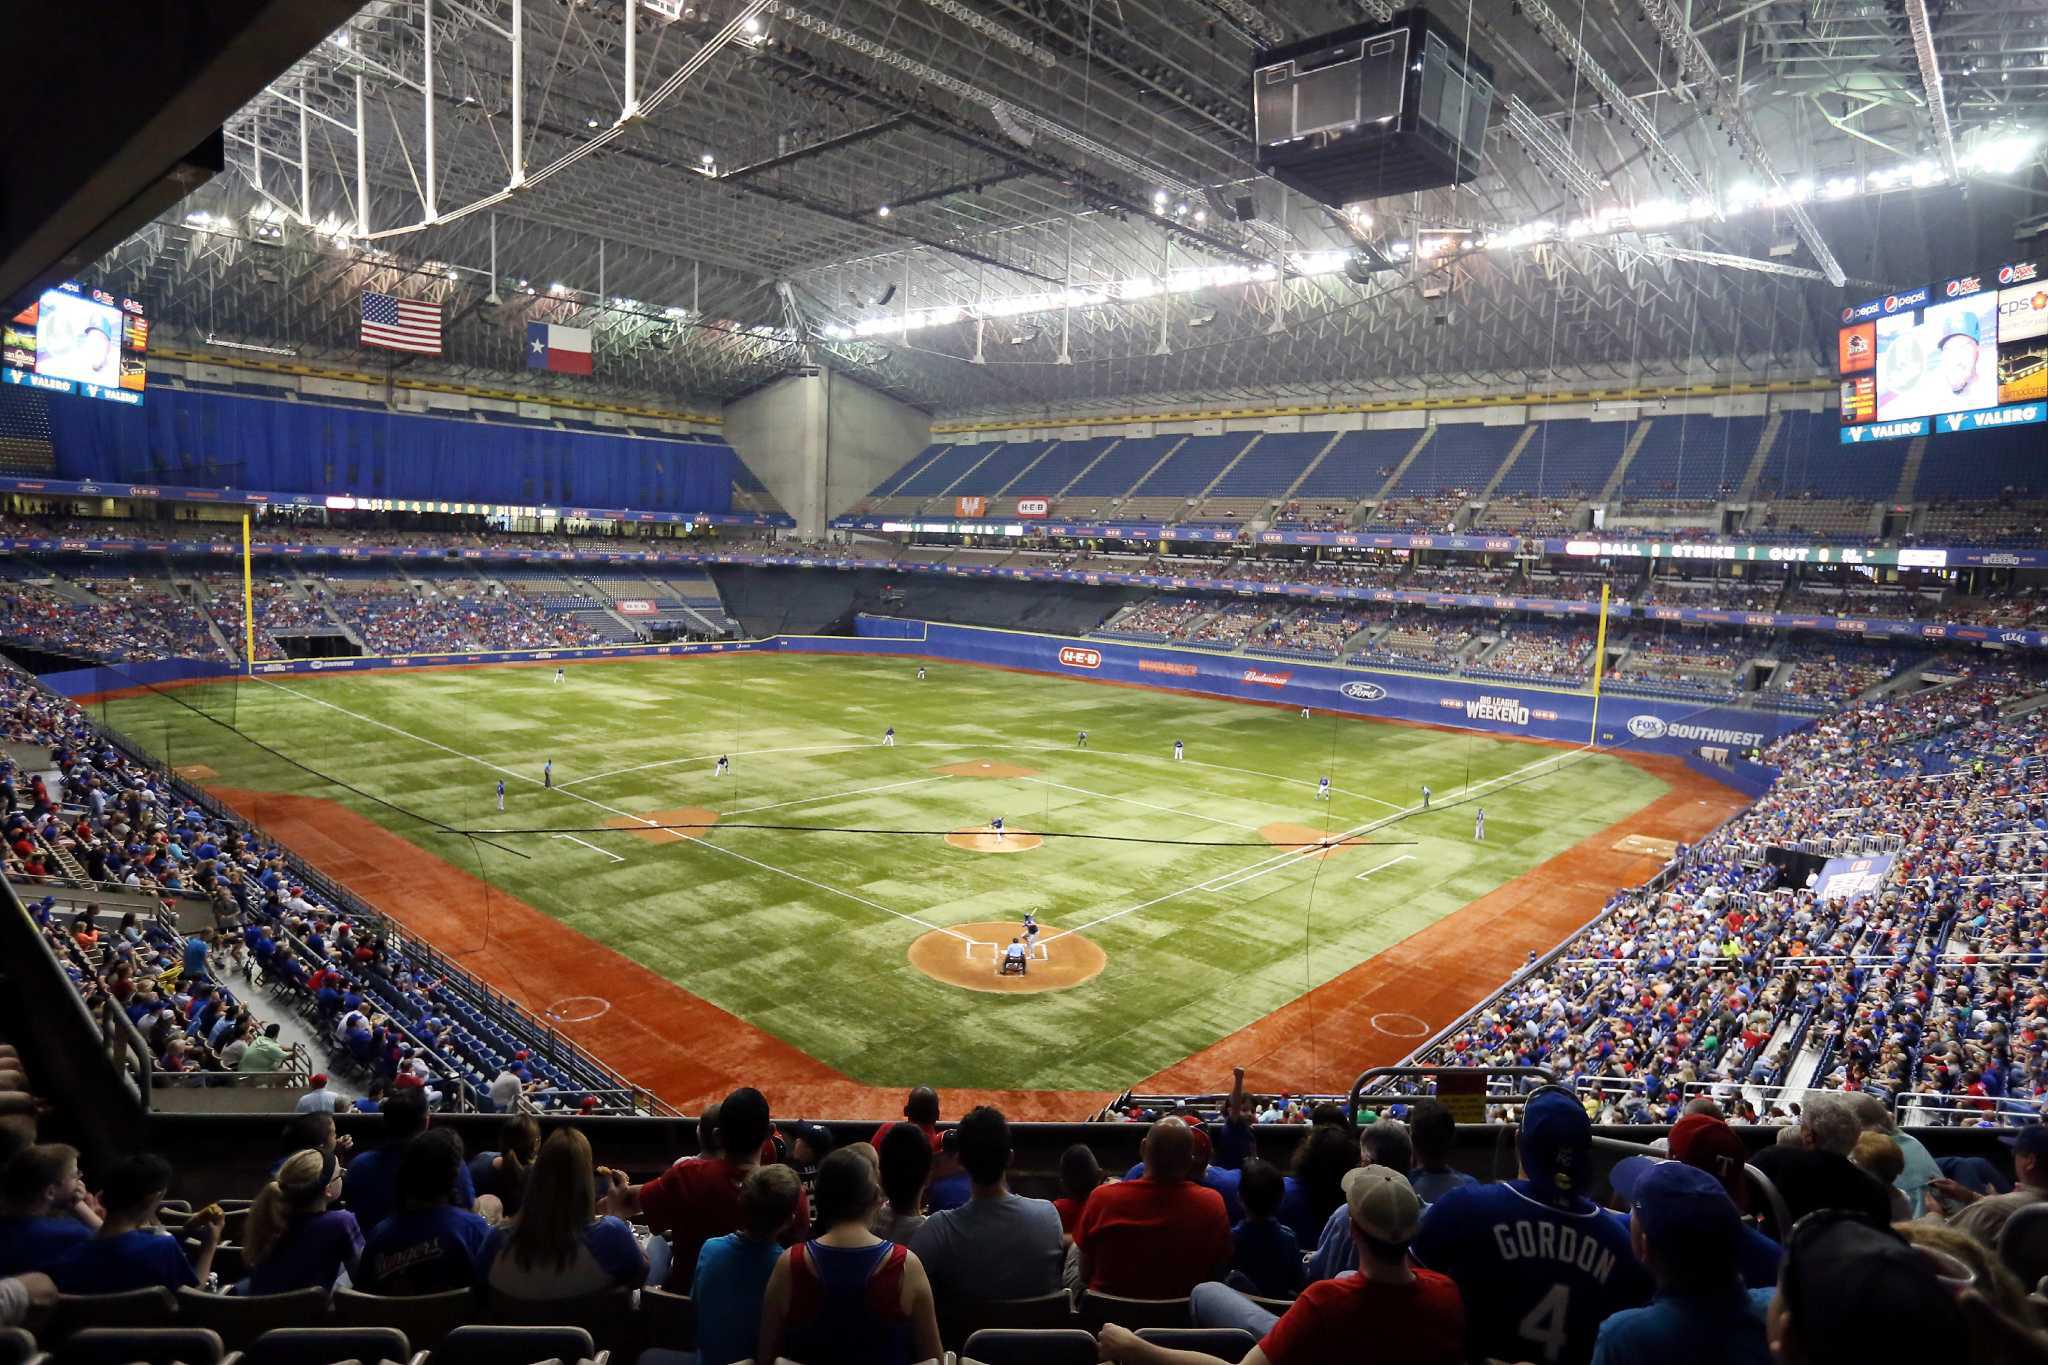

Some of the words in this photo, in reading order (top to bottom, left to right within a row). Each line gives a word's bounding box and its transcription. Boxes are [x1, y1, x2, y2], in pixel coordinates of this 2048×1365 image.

[1898, 290, 1925, 308] pepsi
[2000, 298, 2030, 317] cps
[1855, 302, 1879, 318] pepsi
[31, 375, 71, 391] VALERO
[1974, 407, 2037, 426] VALERO
[1872, 421, 1922, 438] VALERO
[1601, 543, 1641, 556] BALL
[1672, 545, 1735, 559] STRIKE
[1748, 547, 1755, 560] 1
[1769, 548, 1809, 561] OUT
[2001, 632, 2026, 644] TEXAS
[1063, 650, 1097, 664] H-E-B
[1493, 697, 1519, 709] LEAGUE
[1467, 701, 1529, 725] WEEKEND
[1636, 719, 1657, 731] FOX
[1668, 723, 1764, 747] SOUTHWEST
[1716, 1154, 1734, 1177] T
[1494, 1221, 1616, 1284] GORDON
[1518, 1284, 1571, 1362] 4
